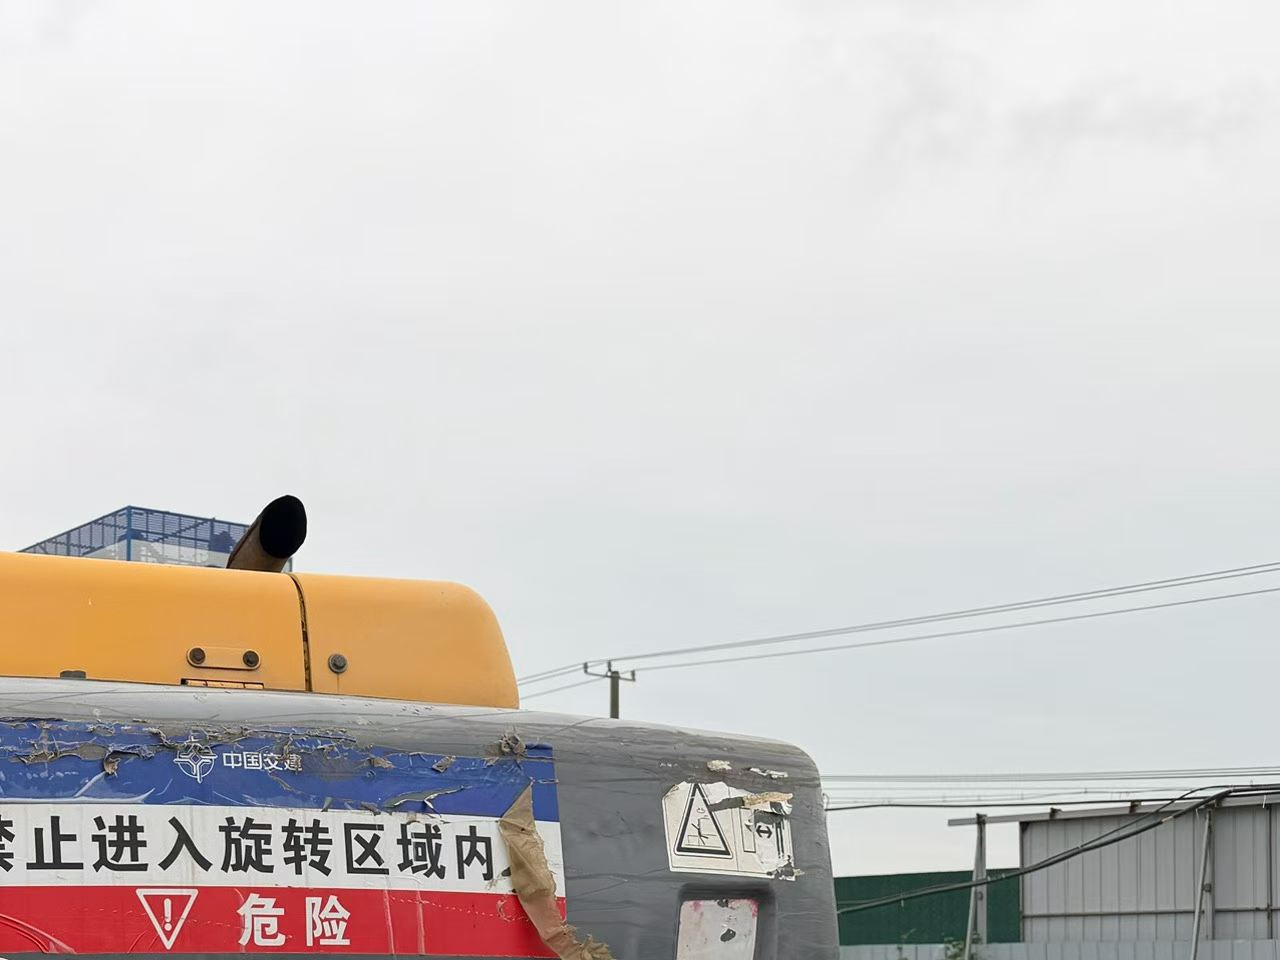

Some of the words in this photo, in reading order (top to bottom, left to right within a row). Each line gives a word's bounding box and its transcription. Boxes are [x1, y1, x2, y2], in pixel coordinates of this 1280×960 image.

[222, 749, 303, 774] 中国交建
[236, 892, 352, 948] 危险
